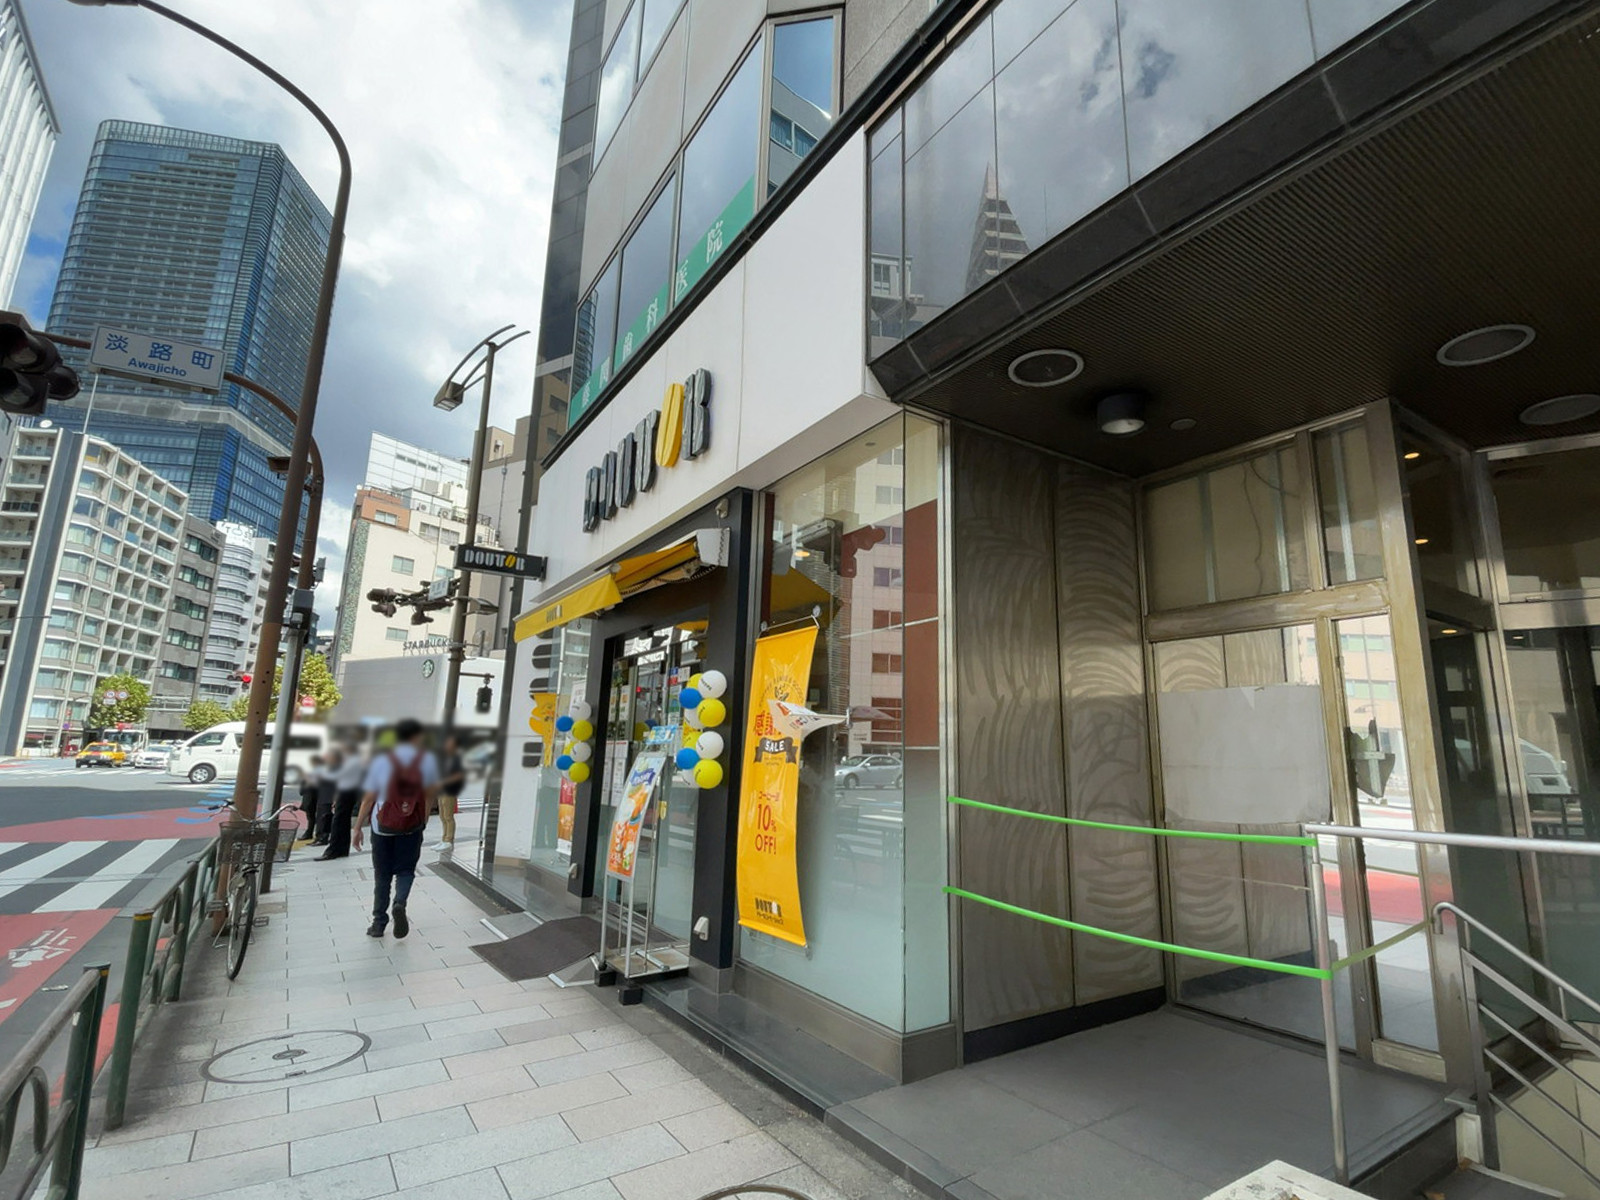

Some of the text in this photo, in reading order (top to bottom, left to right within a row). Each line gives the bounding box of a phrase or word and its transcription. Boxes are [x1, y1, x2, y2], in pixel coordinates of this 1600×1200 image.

[105, 333, 215, 370] 淡路町
[128, 357, 187, 377] Awajicho
[464, 549, 525, 571] DOUTOR
[403, 637, 454, 651] STARBUCKS
[764, 740, 785, 752] SALE
[757, 803, 777, 833] 10%
[754, 833, 777, 856] OFF!
